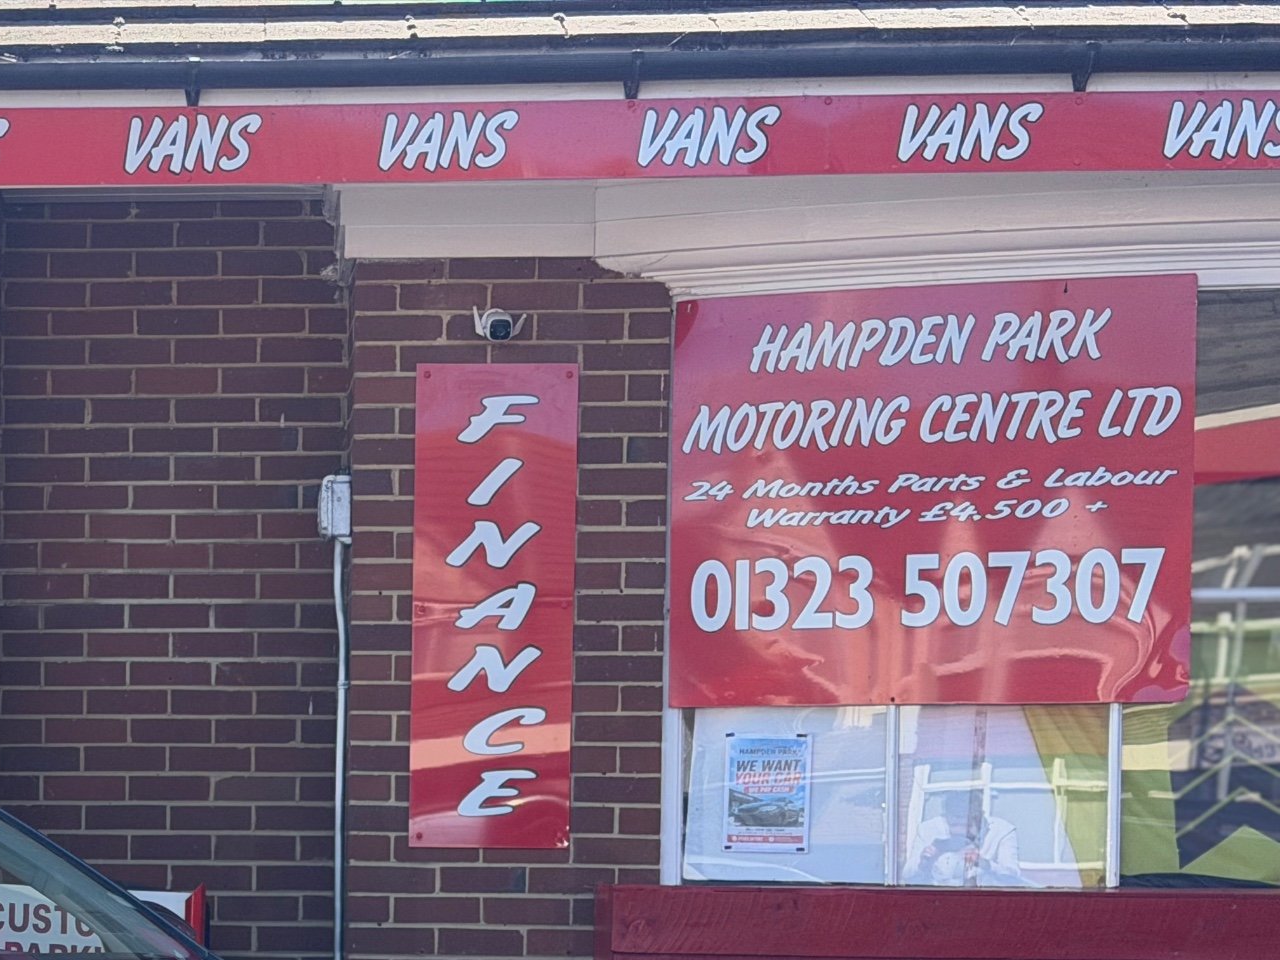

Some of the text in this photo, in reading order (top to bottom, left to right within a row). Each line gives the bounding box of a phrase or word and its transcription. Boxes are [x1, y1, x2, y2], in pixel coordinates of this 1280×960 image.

[124, 113, 262, 174] VANS
[378, 110, 520, 172] VANS
[637, 105, 781, 167] VANS
[898, 103, 1044, 163] VANS
[749, 307, 1112, 373] HAMPDEN PARK
[682, 386, 1182, 454] MOTORING CENTRE LTD
[684, 466, 1178, 501] 24 Months Parts & Labour
[746, 506, 911, 528] Warranty
[918, 498, 1069, 522] £4.500
[445, 395, 546, 817] FINANCE
[690, 547, 1166, 632] 01323 507307
[736, 759, 802, 772] WE WANT
